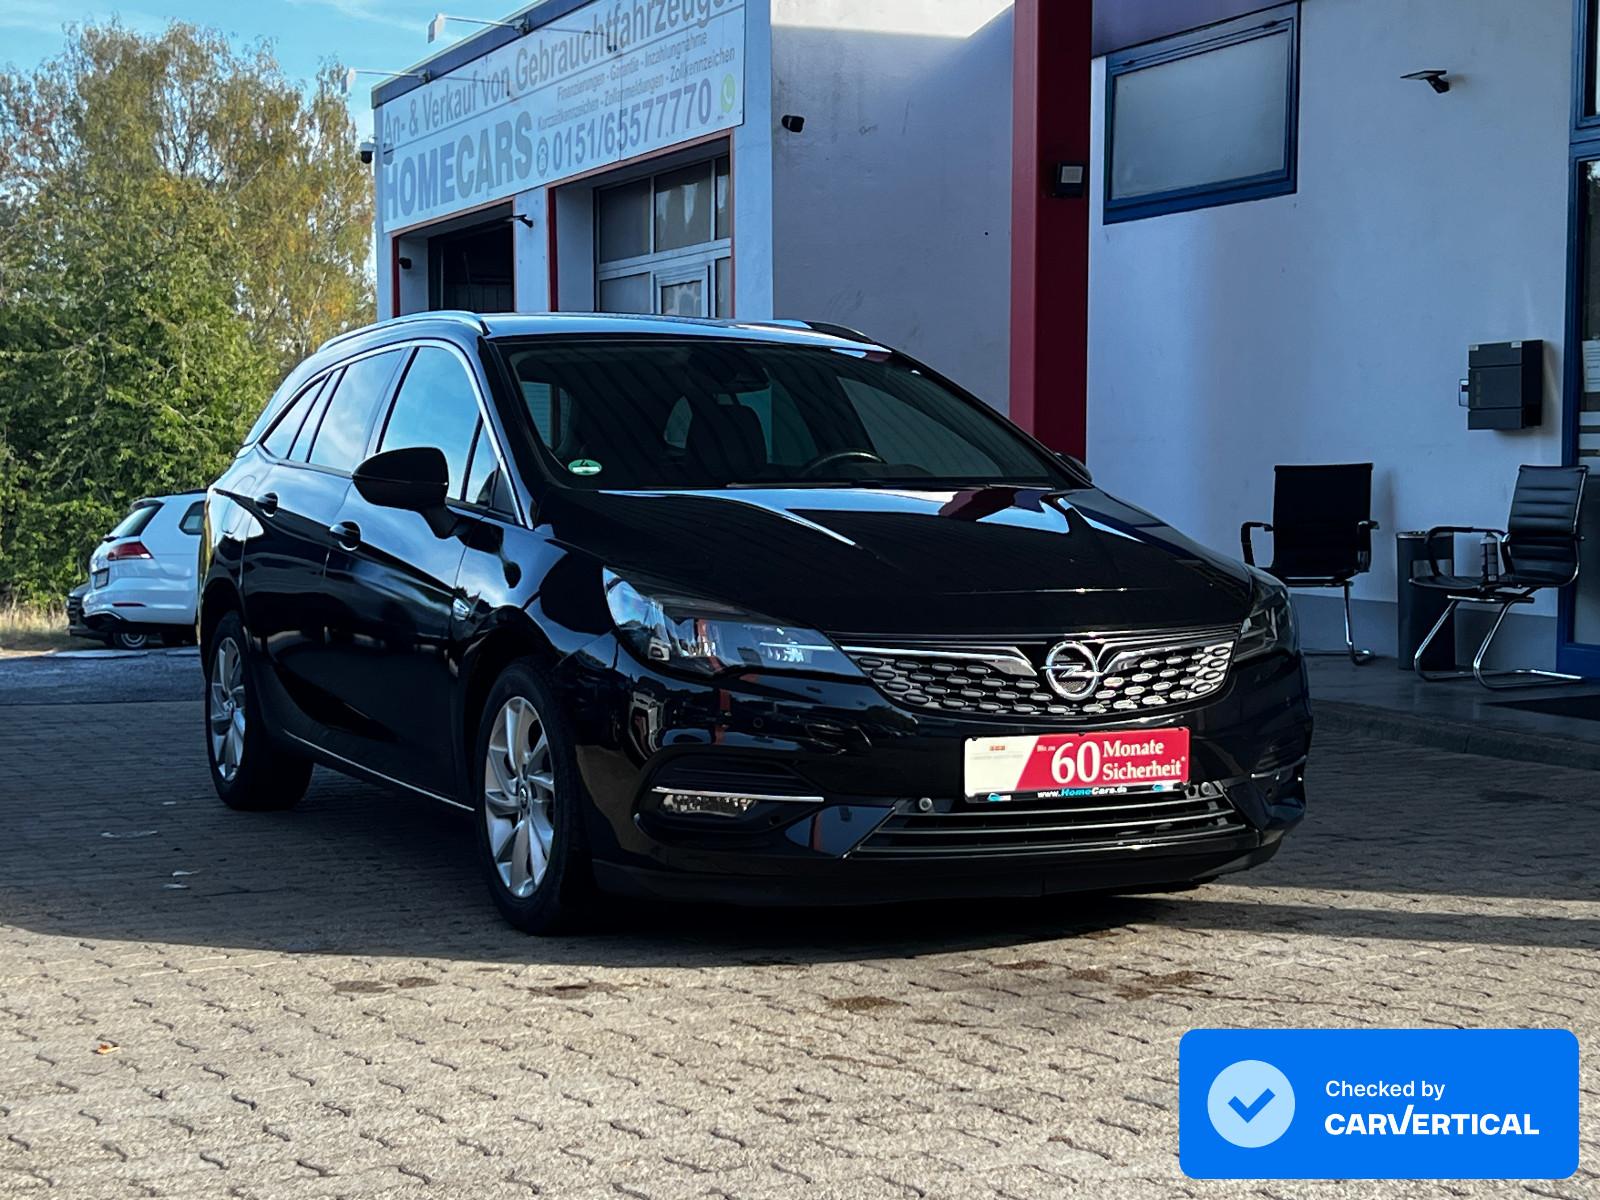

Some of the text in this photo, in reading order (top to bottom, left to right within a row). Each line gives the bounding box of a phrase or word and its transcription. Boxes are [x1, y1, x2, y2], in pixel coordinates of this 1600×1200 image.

[408, 98, 419, 137] &
[422, 70, 478, 131] Verkauf
[481, 66, 511, 106] von
[515, 0, 734, 91] Gebrauchtfahrzeug
[645, 31, 708, 68] Inzahlungnahme
[670, 47, 736, 83] Zollkennzeichen
[383, 111, 533, 222] HOMECARS
[1051, 741, 1101, 784] 60
[1103, 739, 1164, 758] Monate
